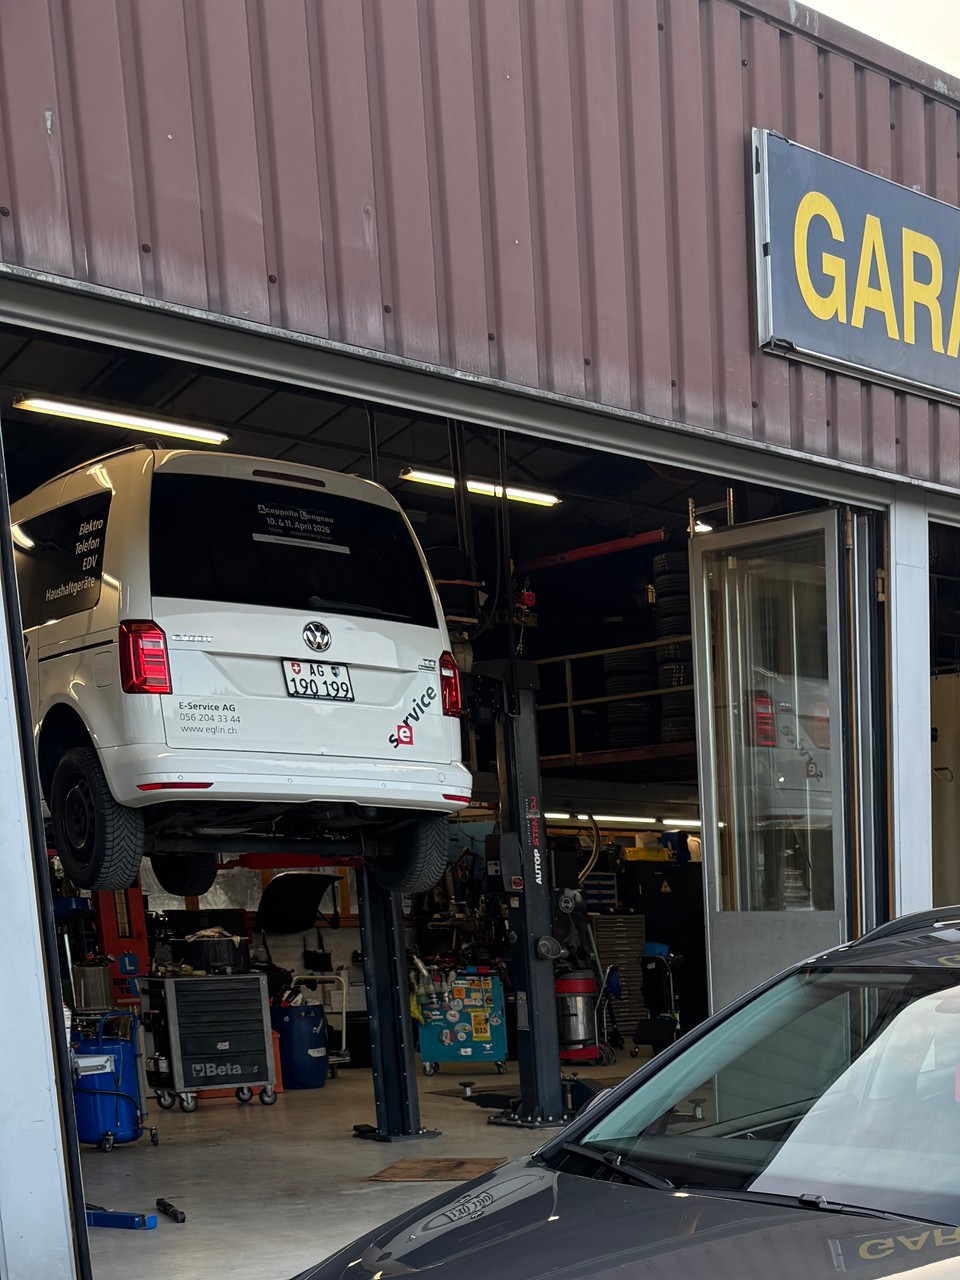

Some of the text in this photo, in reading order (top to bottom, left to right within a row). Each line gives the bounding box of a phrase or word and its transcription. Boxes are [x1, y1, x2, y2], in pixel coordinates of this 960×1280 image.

[79, 519, 104, 536] Elektro
[266, 517, 278, 526] 10.
[285, 520, 294, 528] 11.
[294, 521, 312, 532] April
[75, 536, 100, 555] Telefon
[82, 554, 98, 571] EDV
[45, 575, 96, 602] Haushaltgeräte
[309, 663, 325, 677] AG
[290, 677, 349, 698] 190 199
[178, 702, 236, 713] E-Service AG
[179, 713, 241, 724] 056 204 33 44
[388, 686, 437, 749] service
[180, 724, 238, 736] www.eglin.ch
[529, 796, 543, 885] AUTOP STENOJ
[205, 1062, 242, 1077] Beta
